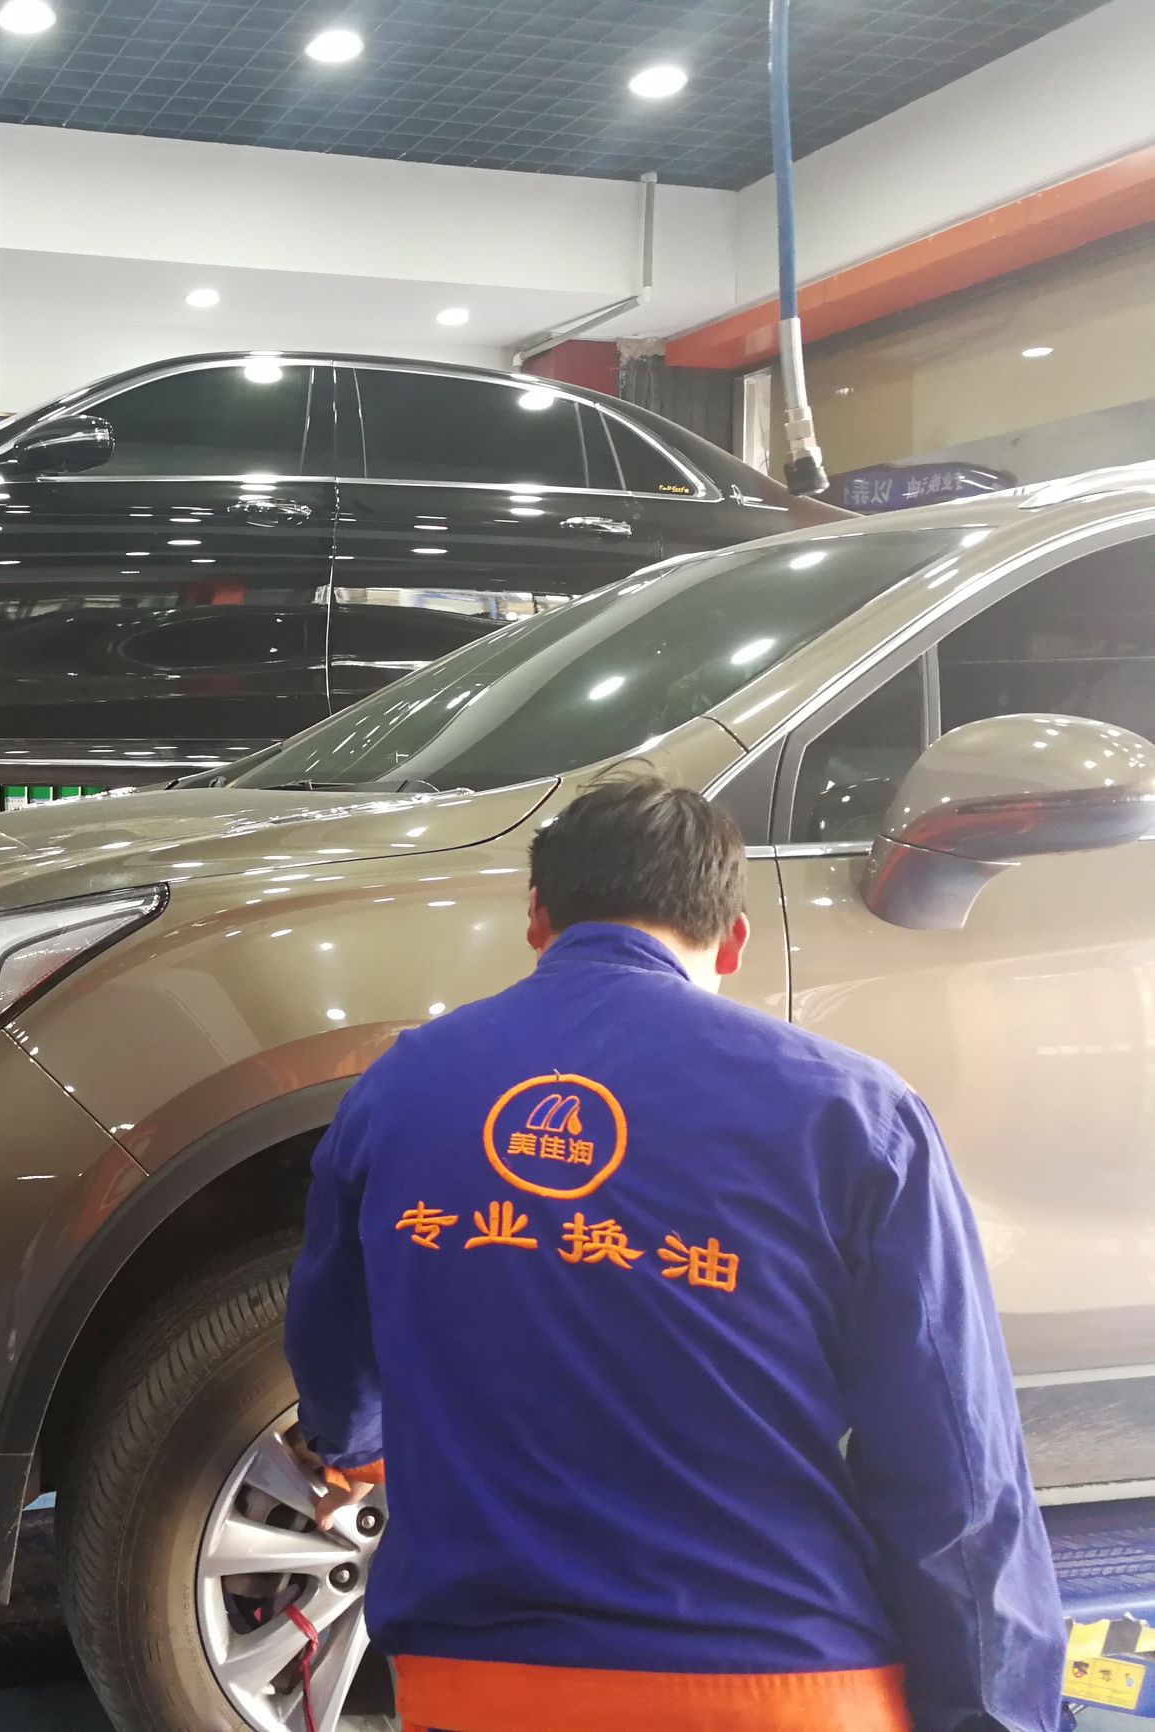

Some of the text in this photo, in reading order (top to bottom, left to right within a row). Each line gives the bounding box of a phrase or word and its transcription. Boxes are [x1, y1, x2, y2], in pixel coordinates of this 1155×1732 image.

[507, 1131, 594, 1166] 美佳润
[395, 1200, 739, 1293] 专业换油
